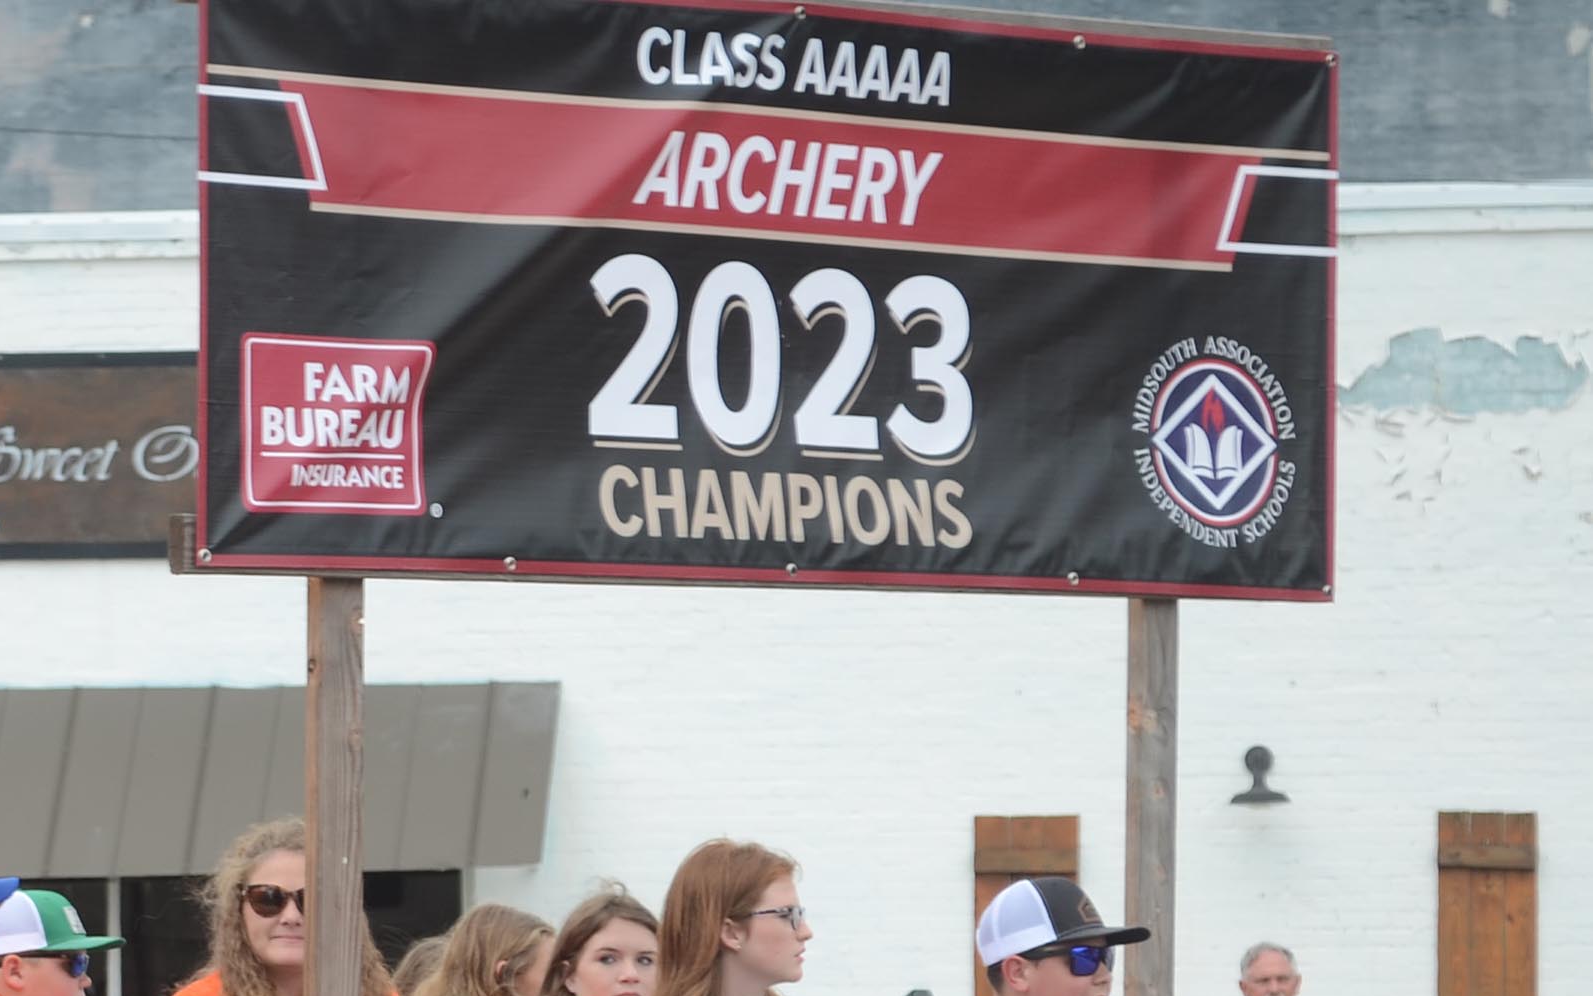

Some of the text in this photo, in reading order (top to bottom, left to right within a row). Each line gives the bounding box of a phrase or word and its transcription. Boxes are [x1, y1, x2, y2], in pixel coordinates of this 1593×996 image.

[637, 27, 952, 106] CLASS AAAAA
[632, 131, 944, 226] ARCHERY
[303, 362, 411, 404] FARM
[588, 253, 975, 464] 2023
[1132, 335, 1296, 440] MIDSOUTH ASSOCIATION
[131, 425, 199, 482] O
[261, 406, 405, 449] BUREAU
[291, 464, 405, 489] INSURANCE
[599, 464, 974, 549] CHAMPIONS
[1134, 448, 1296, 548] INDEPENDENT SCHOOLS
